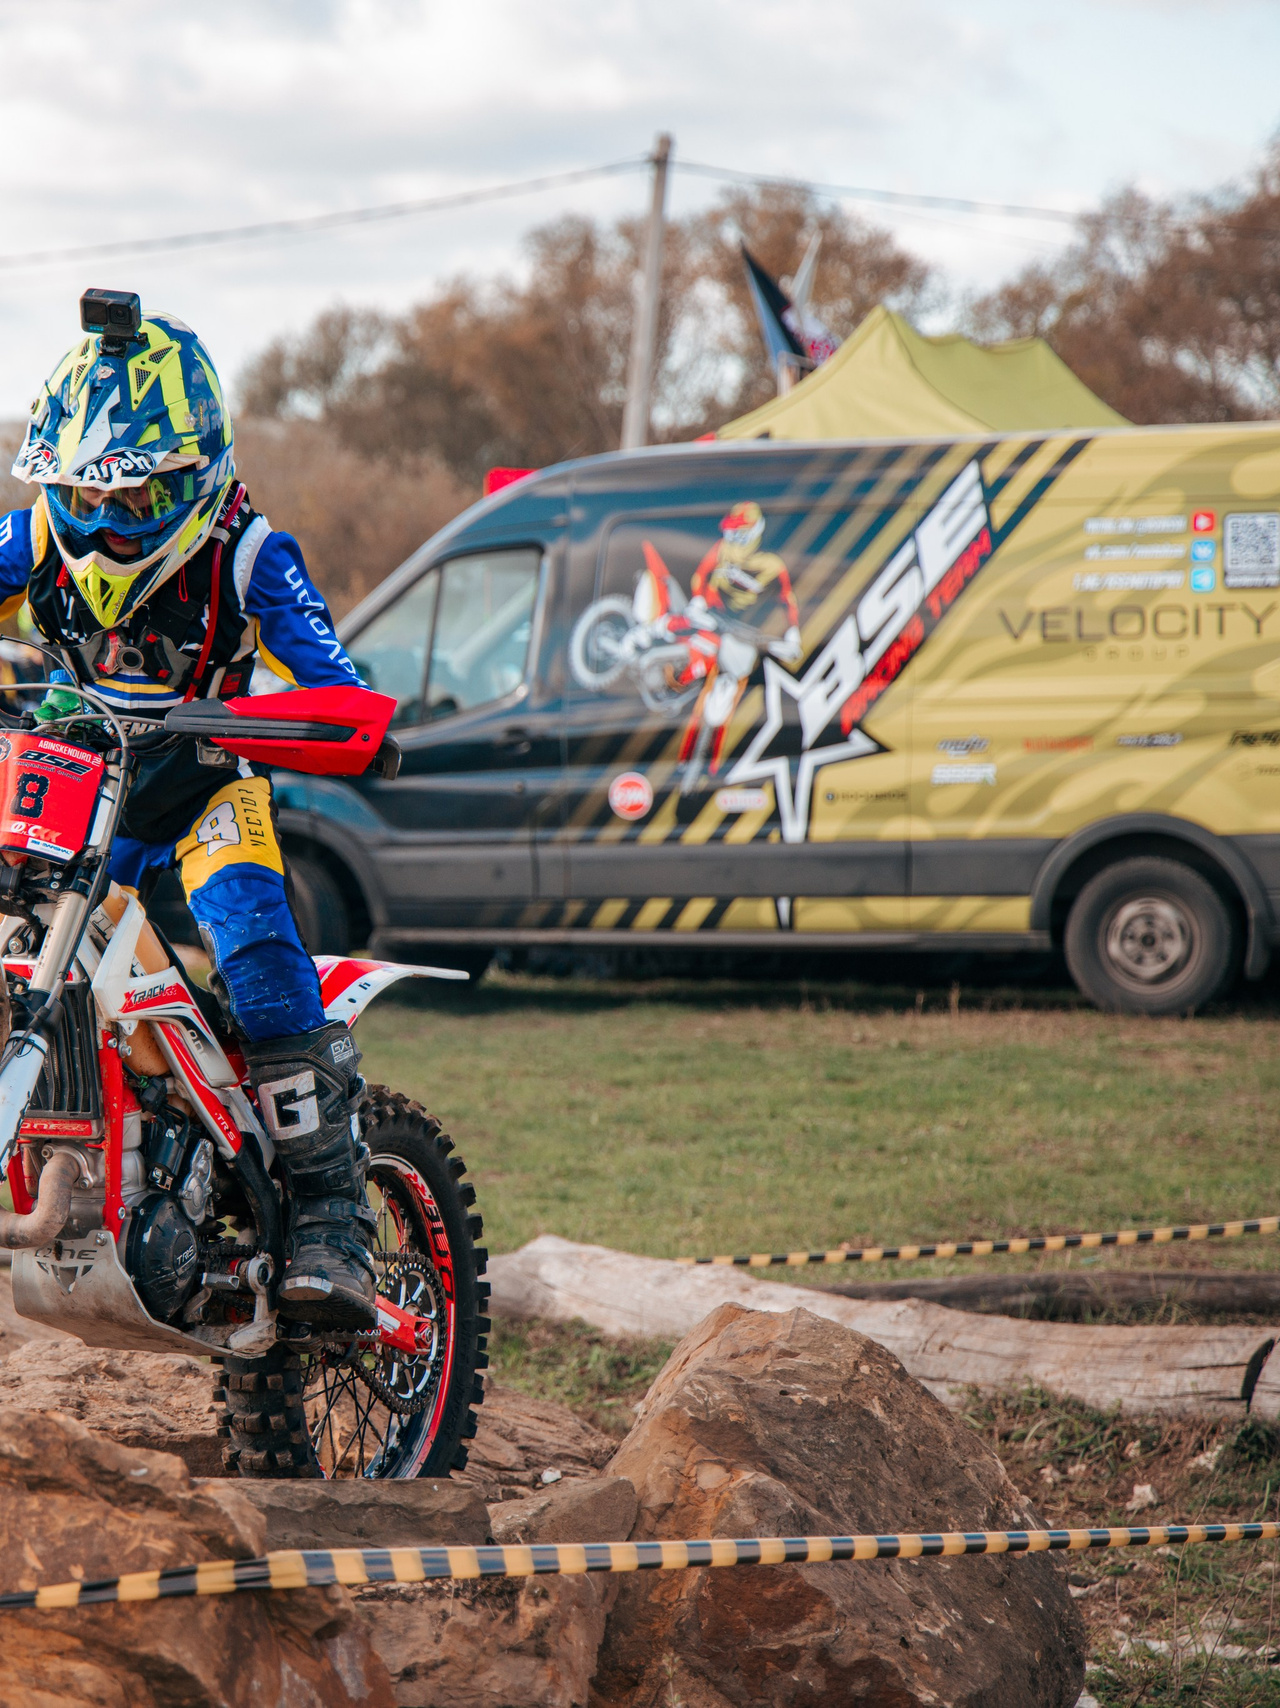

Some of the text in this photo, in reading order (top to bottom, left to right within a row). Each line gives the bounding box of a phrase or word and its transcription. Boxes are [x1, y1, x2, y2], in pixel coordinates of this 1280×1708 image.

[798, 458, 988, 750] BSE
[998, 602, 1279, 641] VELOCITY
[14, 749, 93, 776] BSE
[9, 772, 50, 819] 8
